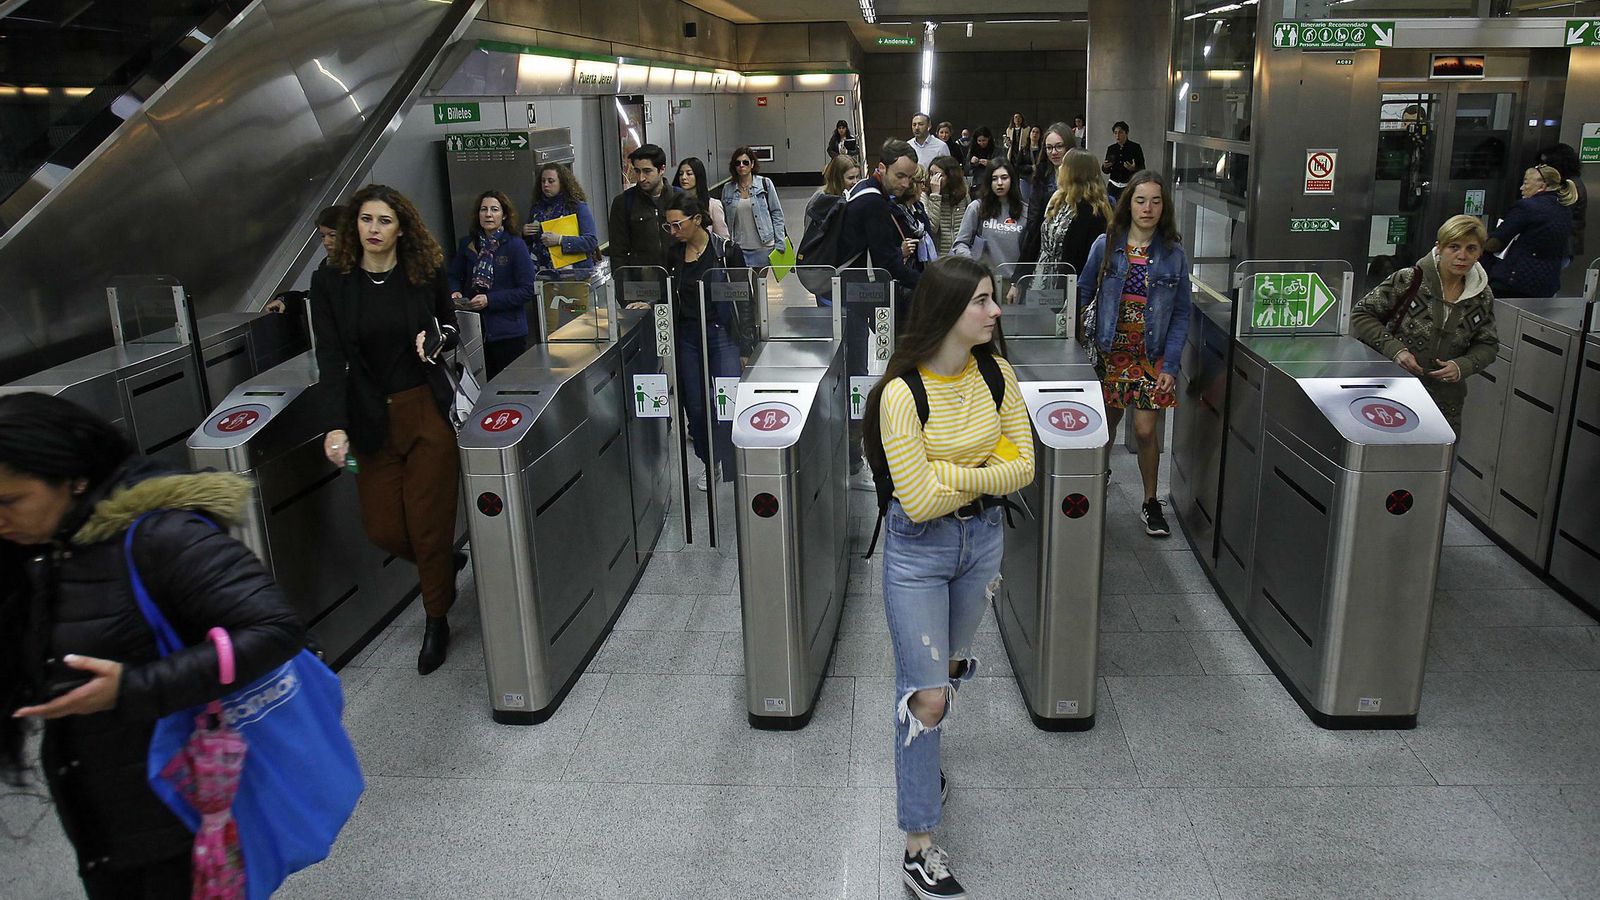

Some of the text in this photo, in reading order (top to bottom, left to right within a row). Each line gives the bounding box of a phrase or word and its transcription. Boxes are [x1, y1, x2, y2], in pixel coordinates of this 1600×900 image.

[578, 71, 612, 84] Puerta Jerez
[447, 107, 472, 120] Billetes
[983, 218, 1023, 232] ellesse
